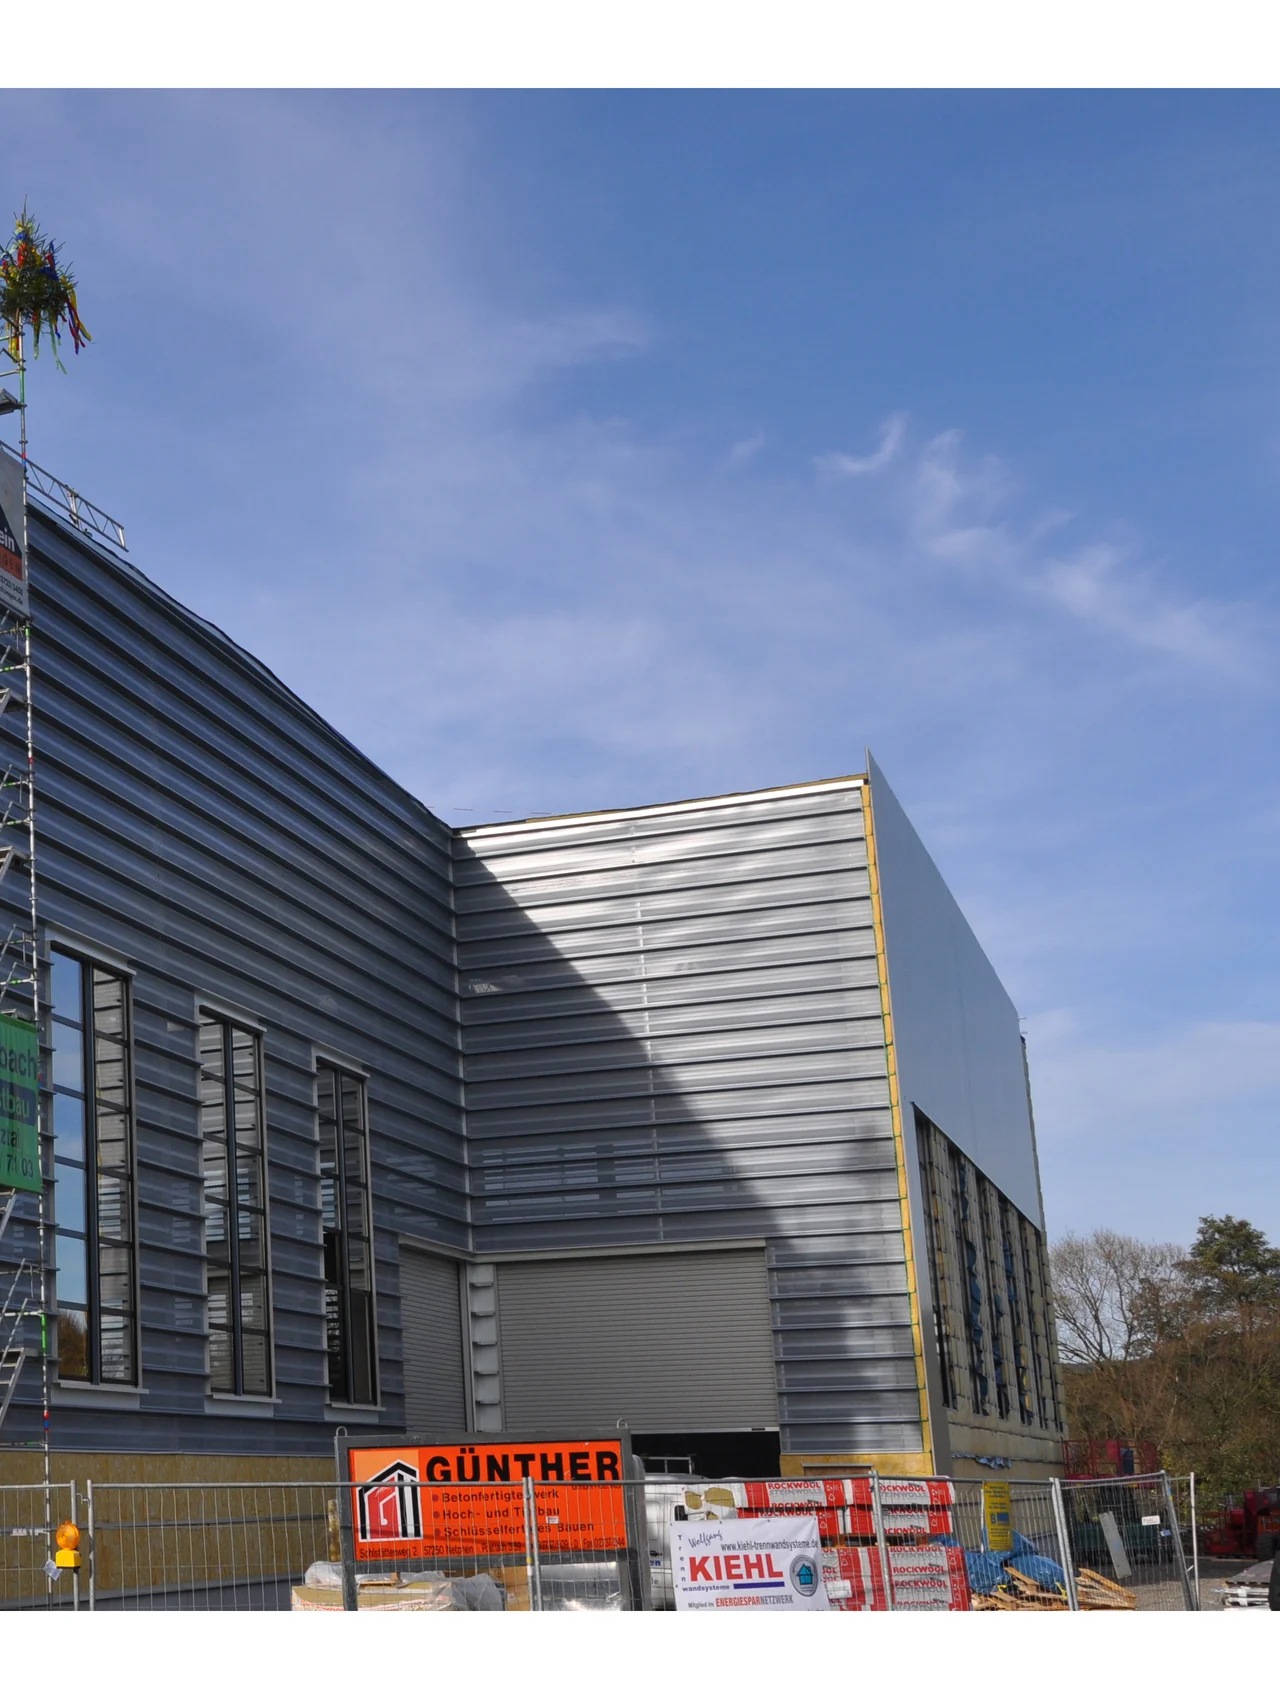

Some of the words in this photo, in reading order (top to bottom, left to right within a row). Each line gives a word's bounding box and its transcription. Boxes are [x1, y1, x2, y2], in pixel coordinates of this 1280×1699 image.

[426, 1447, 620, 1487] GÜNTHER
[486, 1506, 509, 1518] und
[557, 1522, 594, 1533] Bauen
[688, 1530, 723, 1549] Wolfgang
[721, 1539, 819, 1551] www.kiehl-trennwandsysteme.de
[424, 1545, 444, 1556] 57250
[688, 1553, 784, 1582] KIEHL
[893, 1566, 946, 1574] ROCKWOOL
[682, 1583, 730, 1593] wandsysteme
[894, 1580, 948, 1588] ROCKWOOL
[688, 1601, 707, 1609] Mitglied
[715, 1594, 794, 1608] ENERGIESPARNETZWERK
